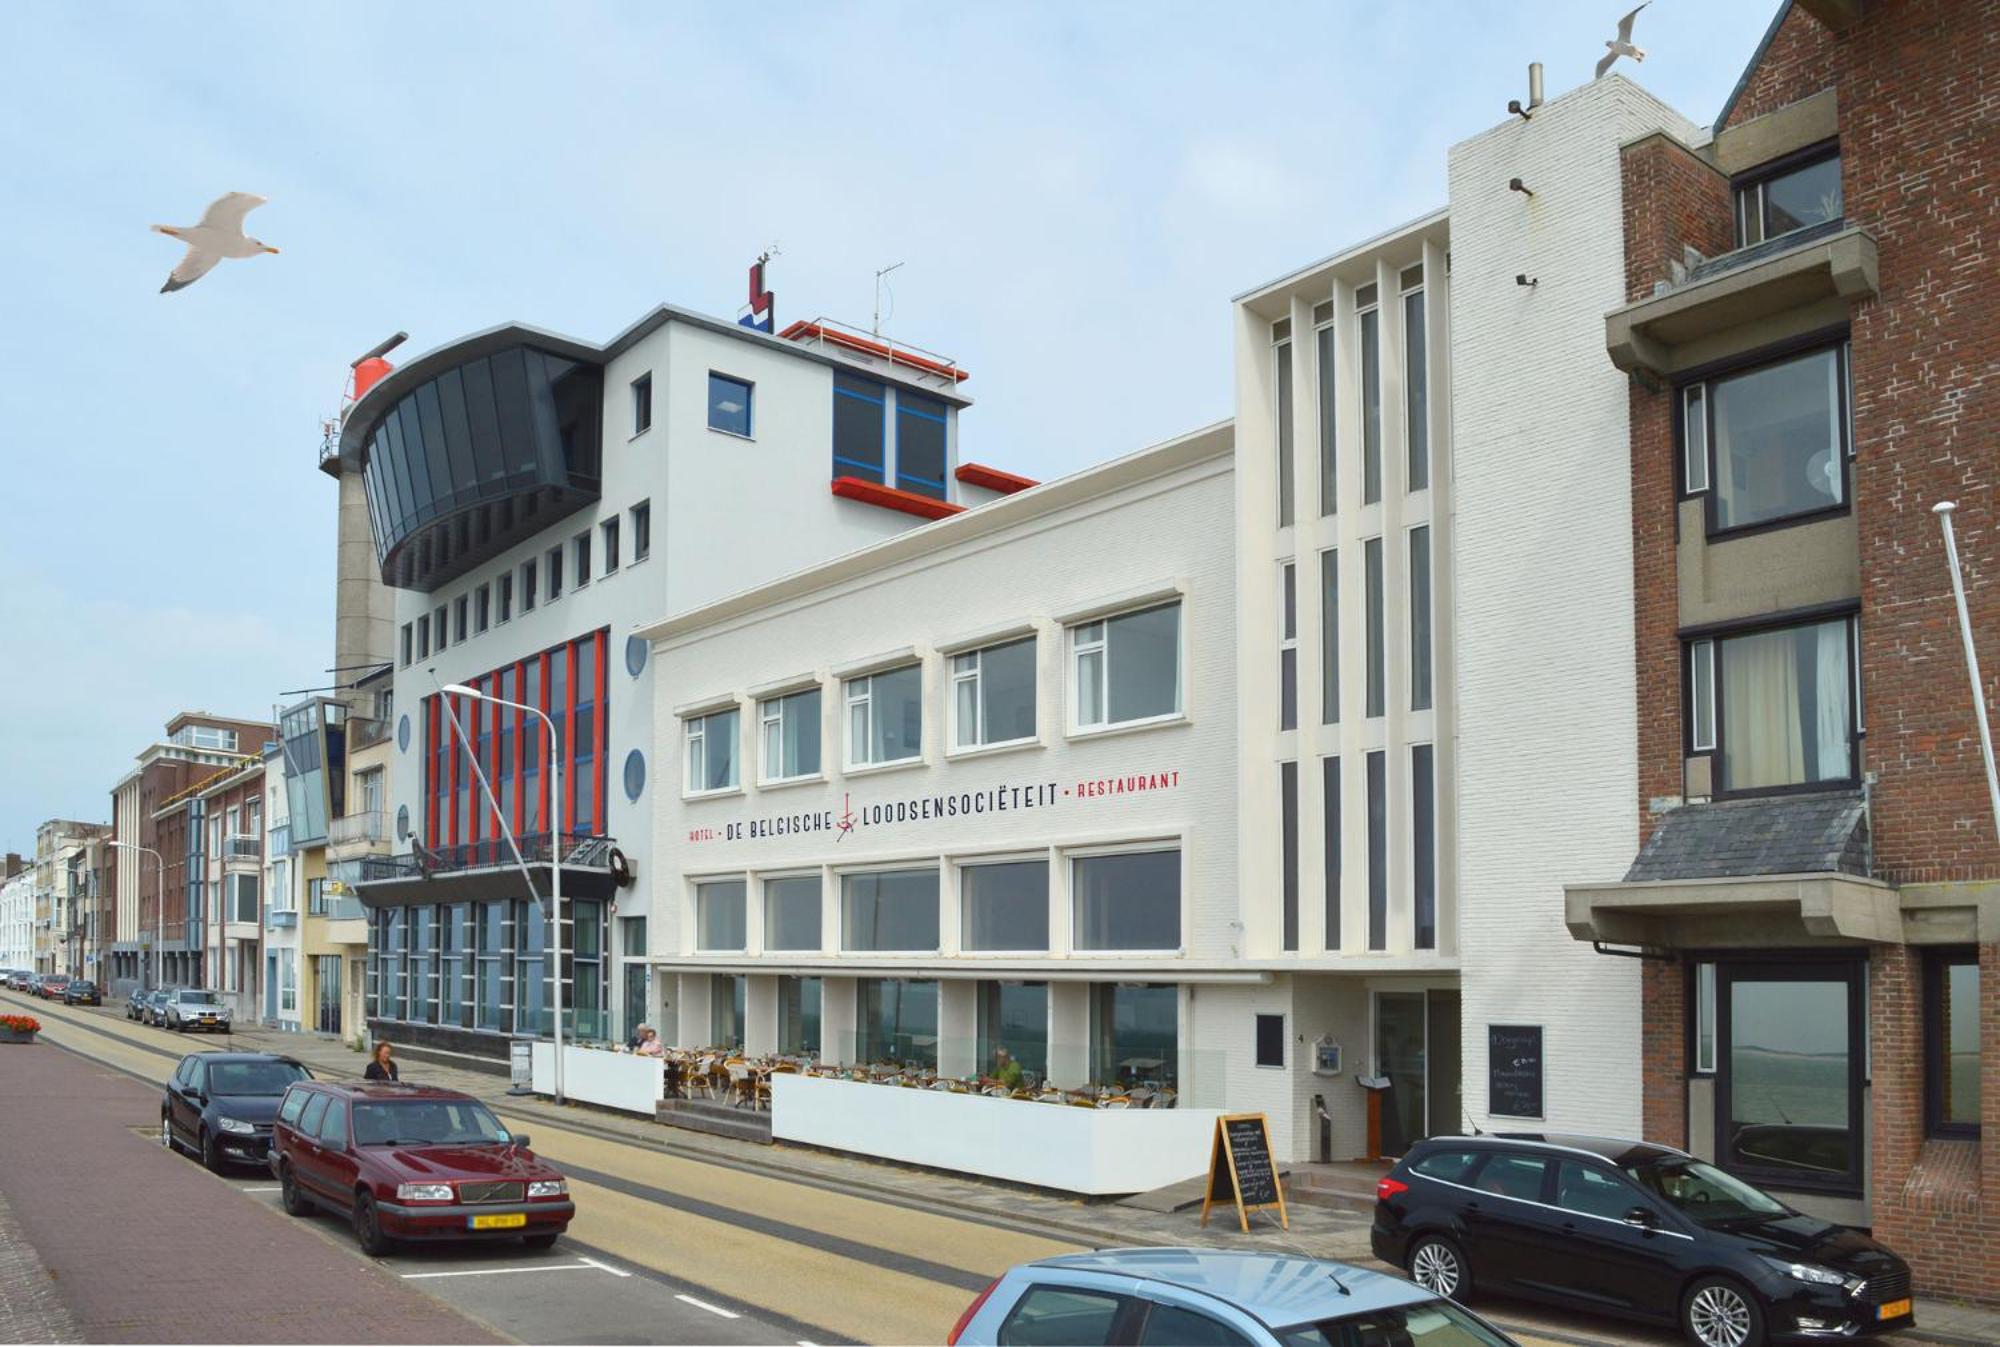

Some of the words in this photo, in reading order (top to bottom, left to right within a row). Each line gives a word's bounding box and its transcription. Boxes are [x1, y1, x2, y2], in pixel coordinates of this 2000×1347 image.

[689, 829, 714, 842] HOTEL
[727, 822, 742, 841] DE
[750, 811, 832, 838] BELGISCHE
[863, 783, 1057, 826] LOODSENSOCIËTEIT
[1077, 771, 1179, 798] RESTAURANT
